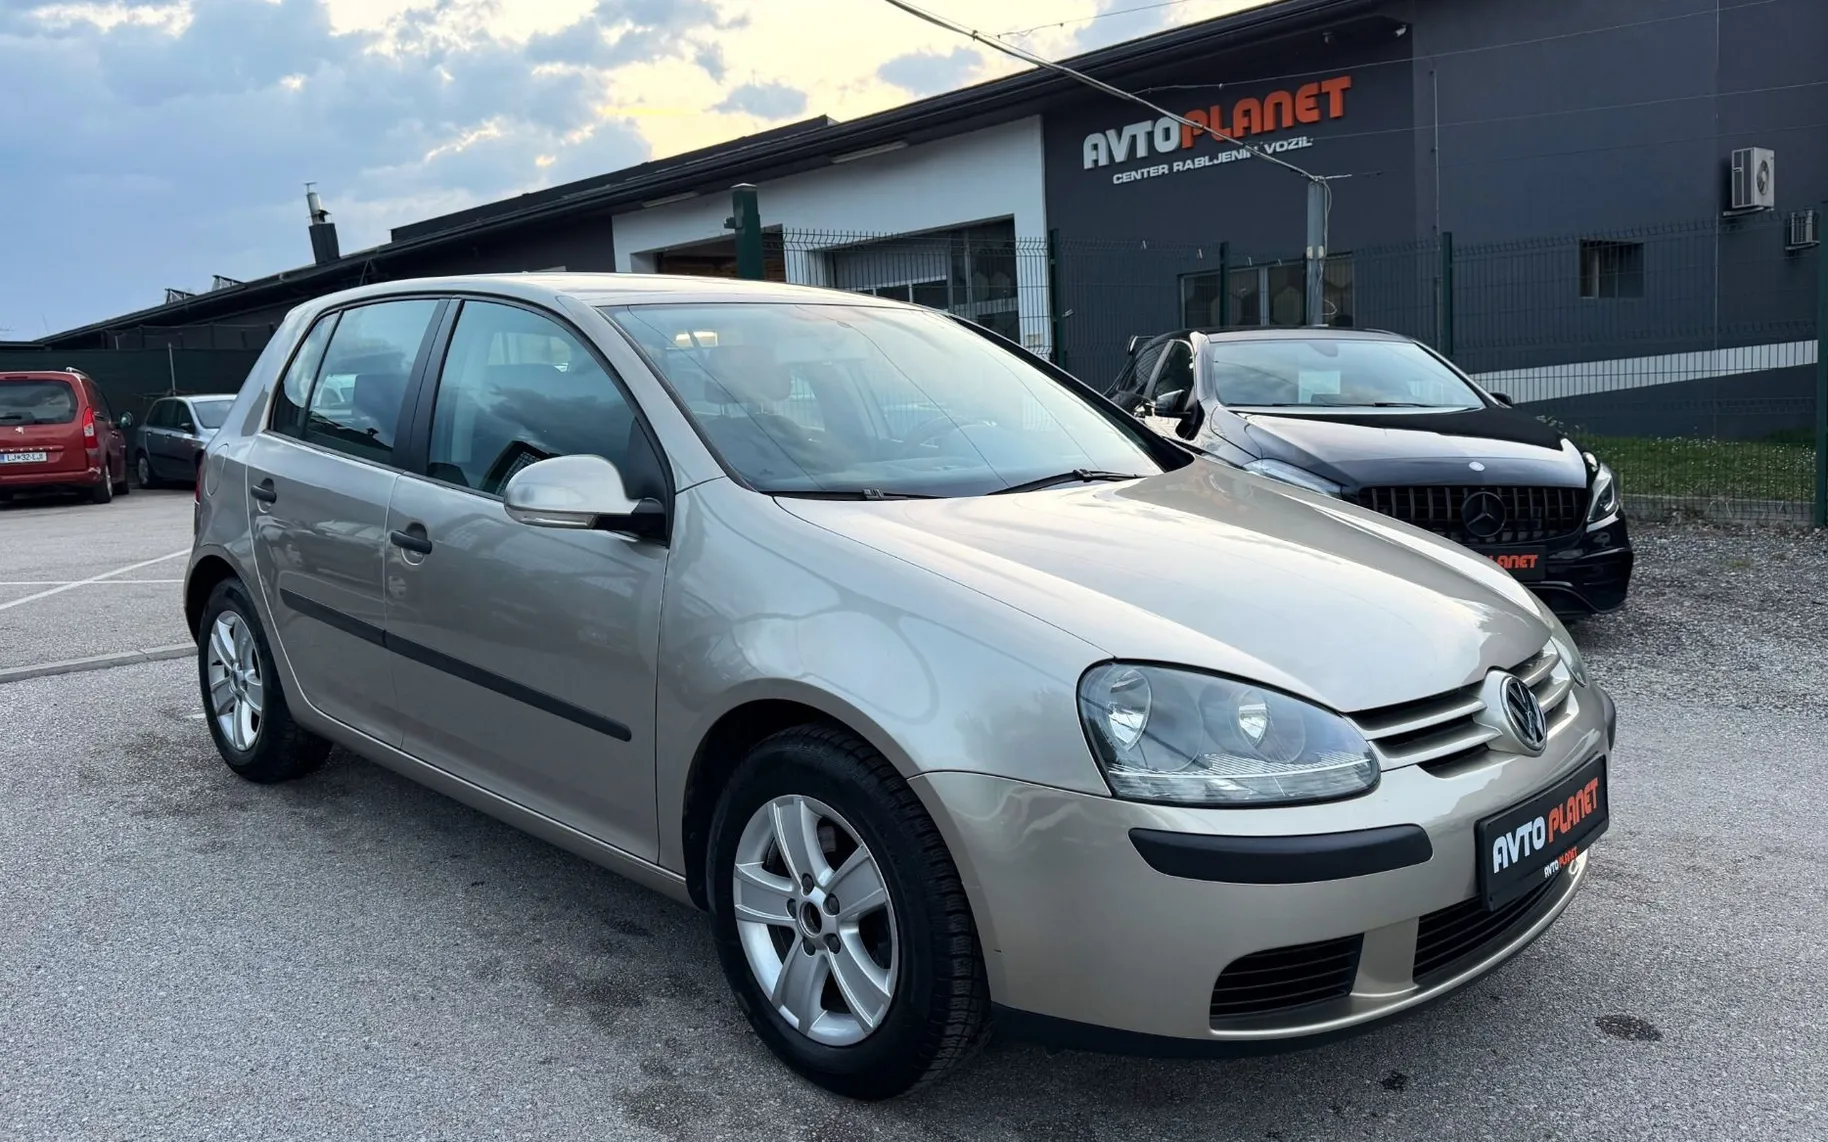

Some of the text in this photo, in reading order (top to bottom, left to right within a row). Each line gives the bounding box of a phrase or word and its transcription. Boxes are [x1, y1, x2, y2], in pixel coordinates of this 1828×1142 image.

[1113, 164, 1169, 184] CENTER
[1264, 136, 1313, 154] VOZIL
[1493, 777, 1599, 873] AVTO PLANET
[1544, 846, 1577, 878] AVTO PLANET
